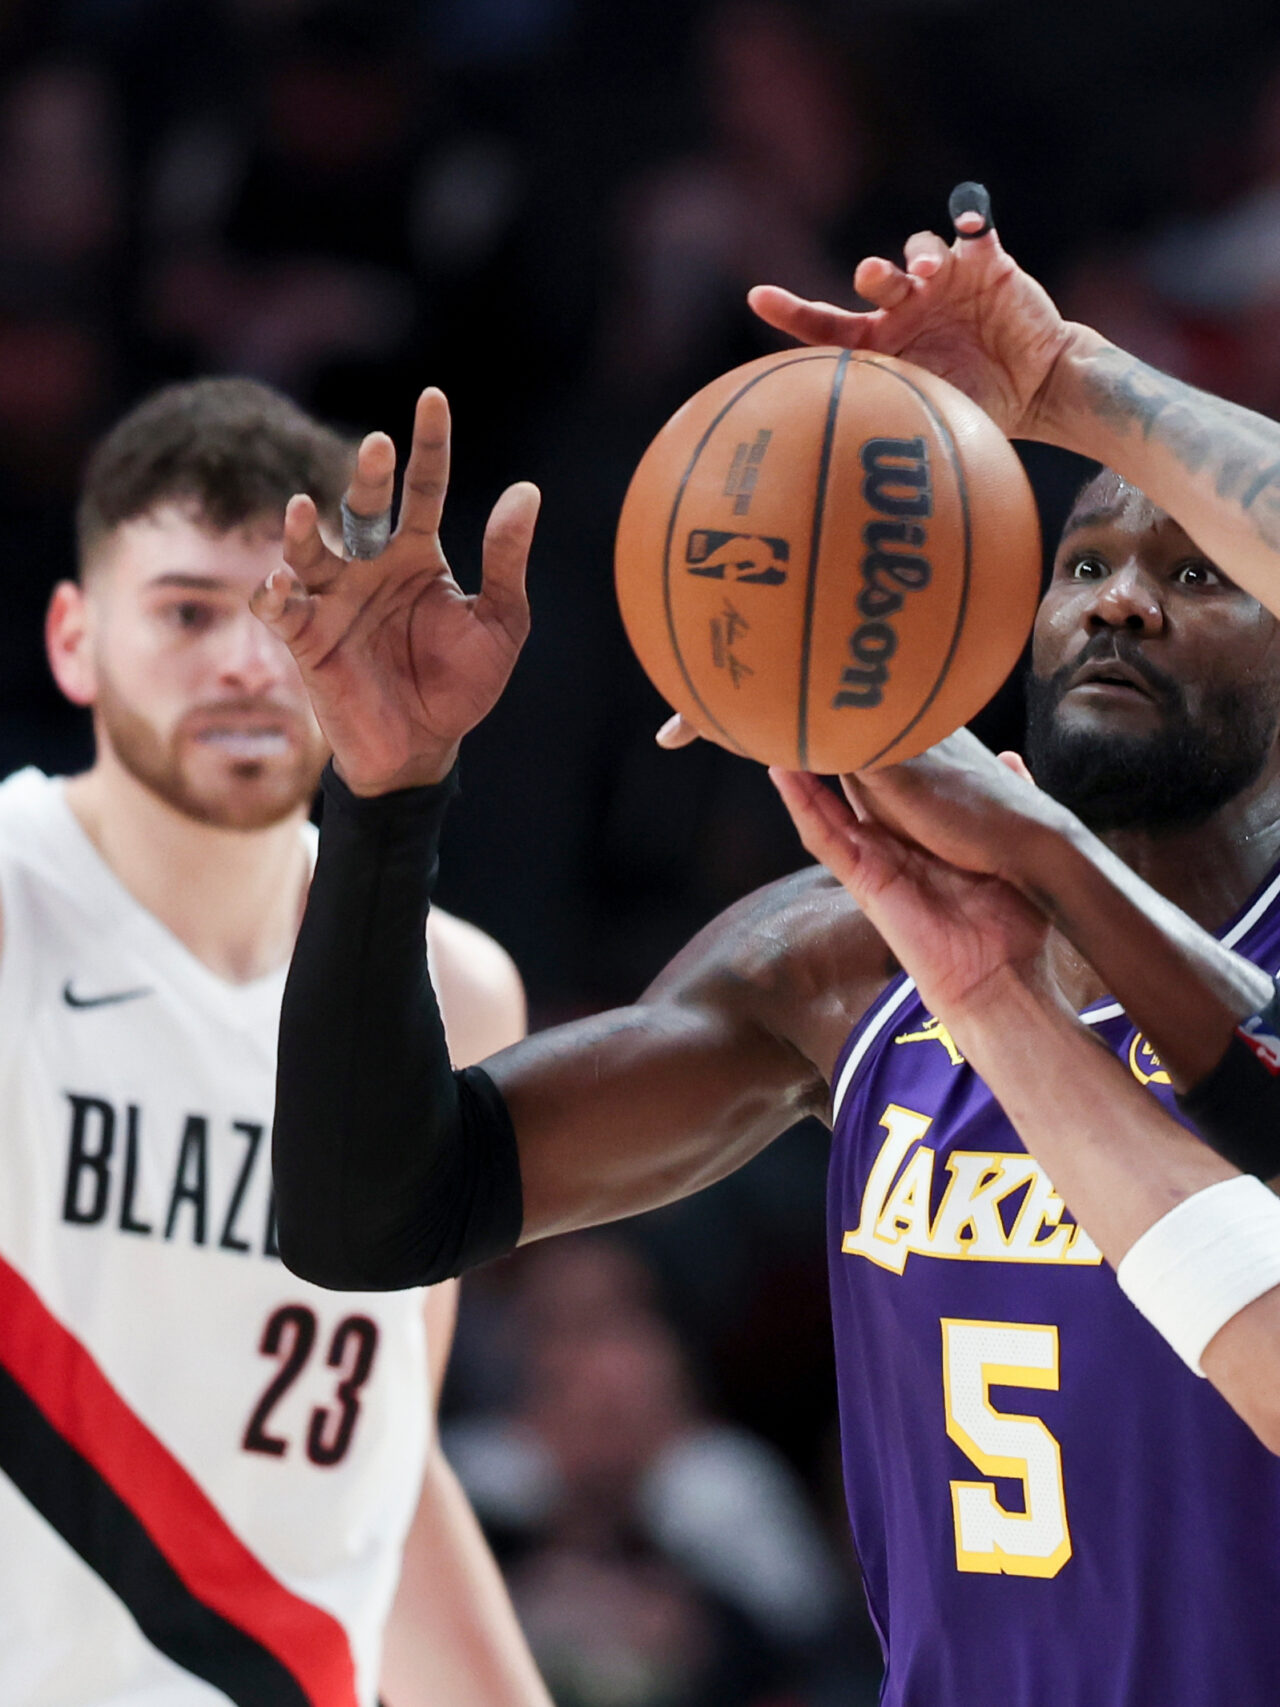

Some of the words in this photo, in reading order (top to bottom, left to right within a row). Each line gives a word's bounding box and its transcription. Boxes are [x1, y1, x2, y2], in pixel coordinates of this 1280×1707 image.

[832, 436, 933, 710] Wilson
[62, 1091, 280, 1259] BLAZ
[241, 1302, 379, 1467] 23
[940, 1318, 1072, 1579] 5
